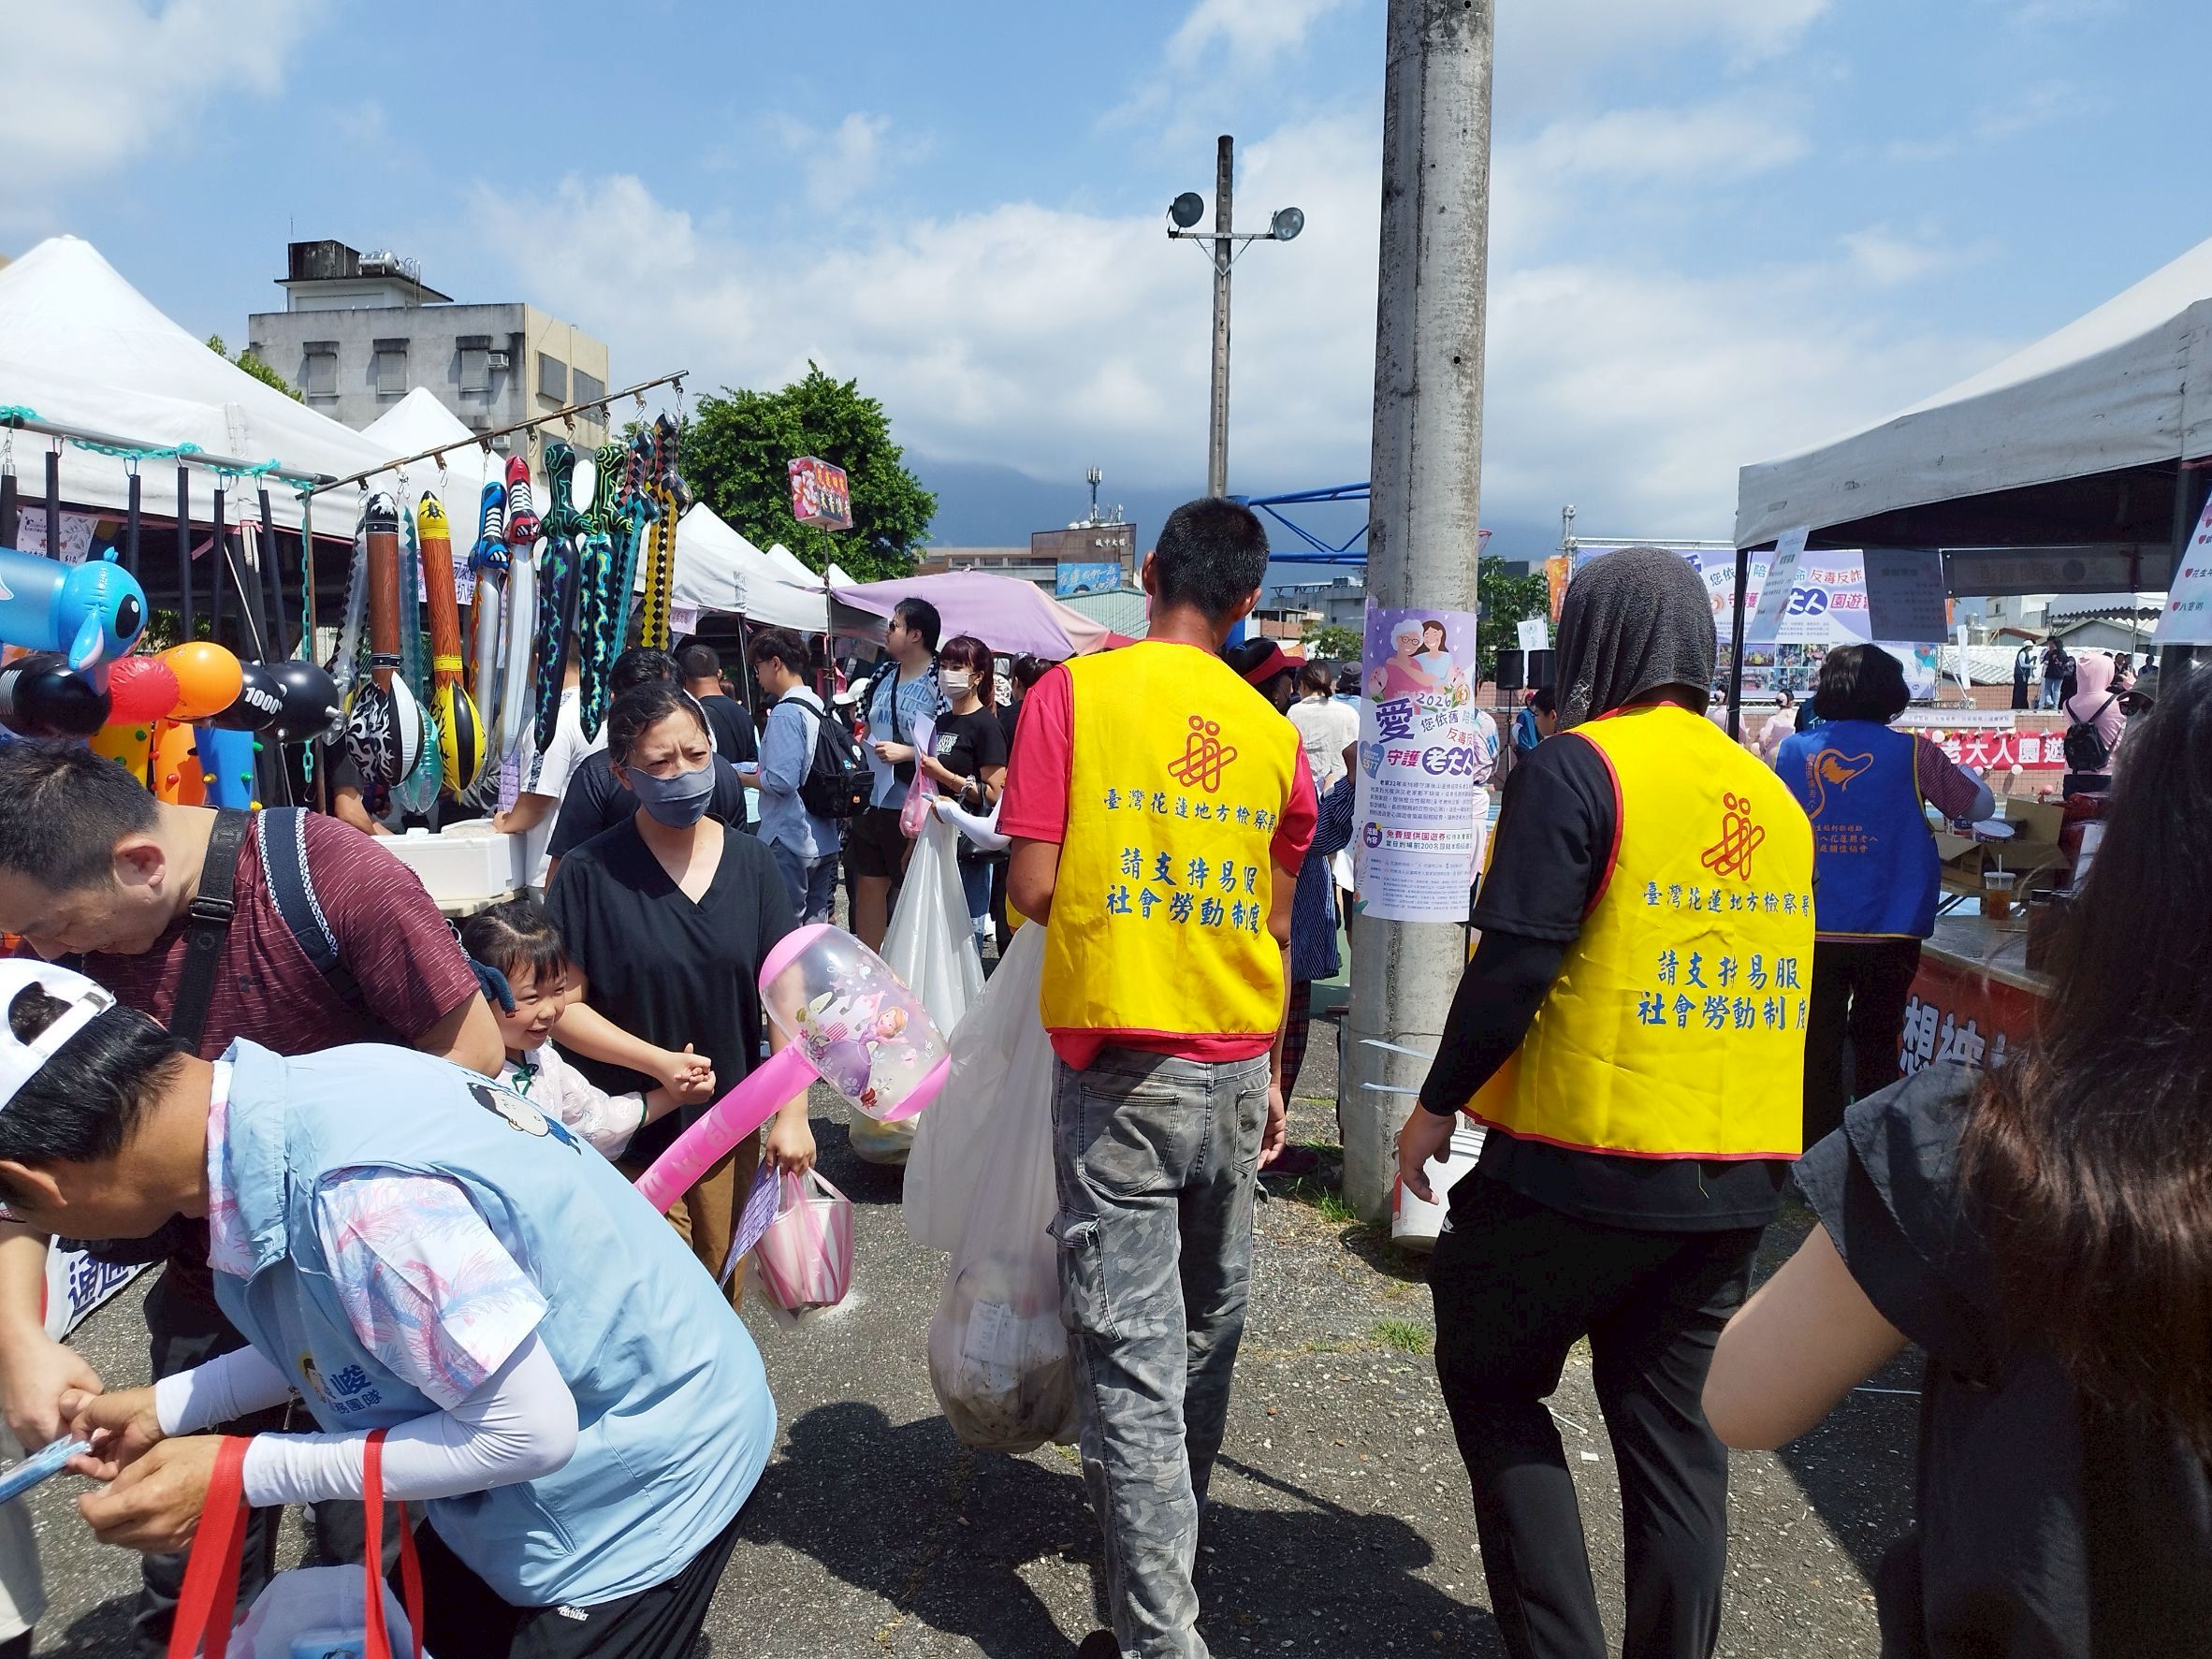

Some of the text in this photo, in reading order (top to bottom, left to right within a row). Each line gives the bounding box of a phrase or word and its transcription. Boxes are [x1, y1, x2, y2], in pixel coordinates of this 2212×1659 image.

[1417, 692, 1451, 707] 2026
[1375, 697, 1416, 745] 愛
[1387, 749, 1421, 767] 守護
[1106, 884, 1260, 934] 社會勞動制度
[1658, 950, 1801, 991] 請支持易服
